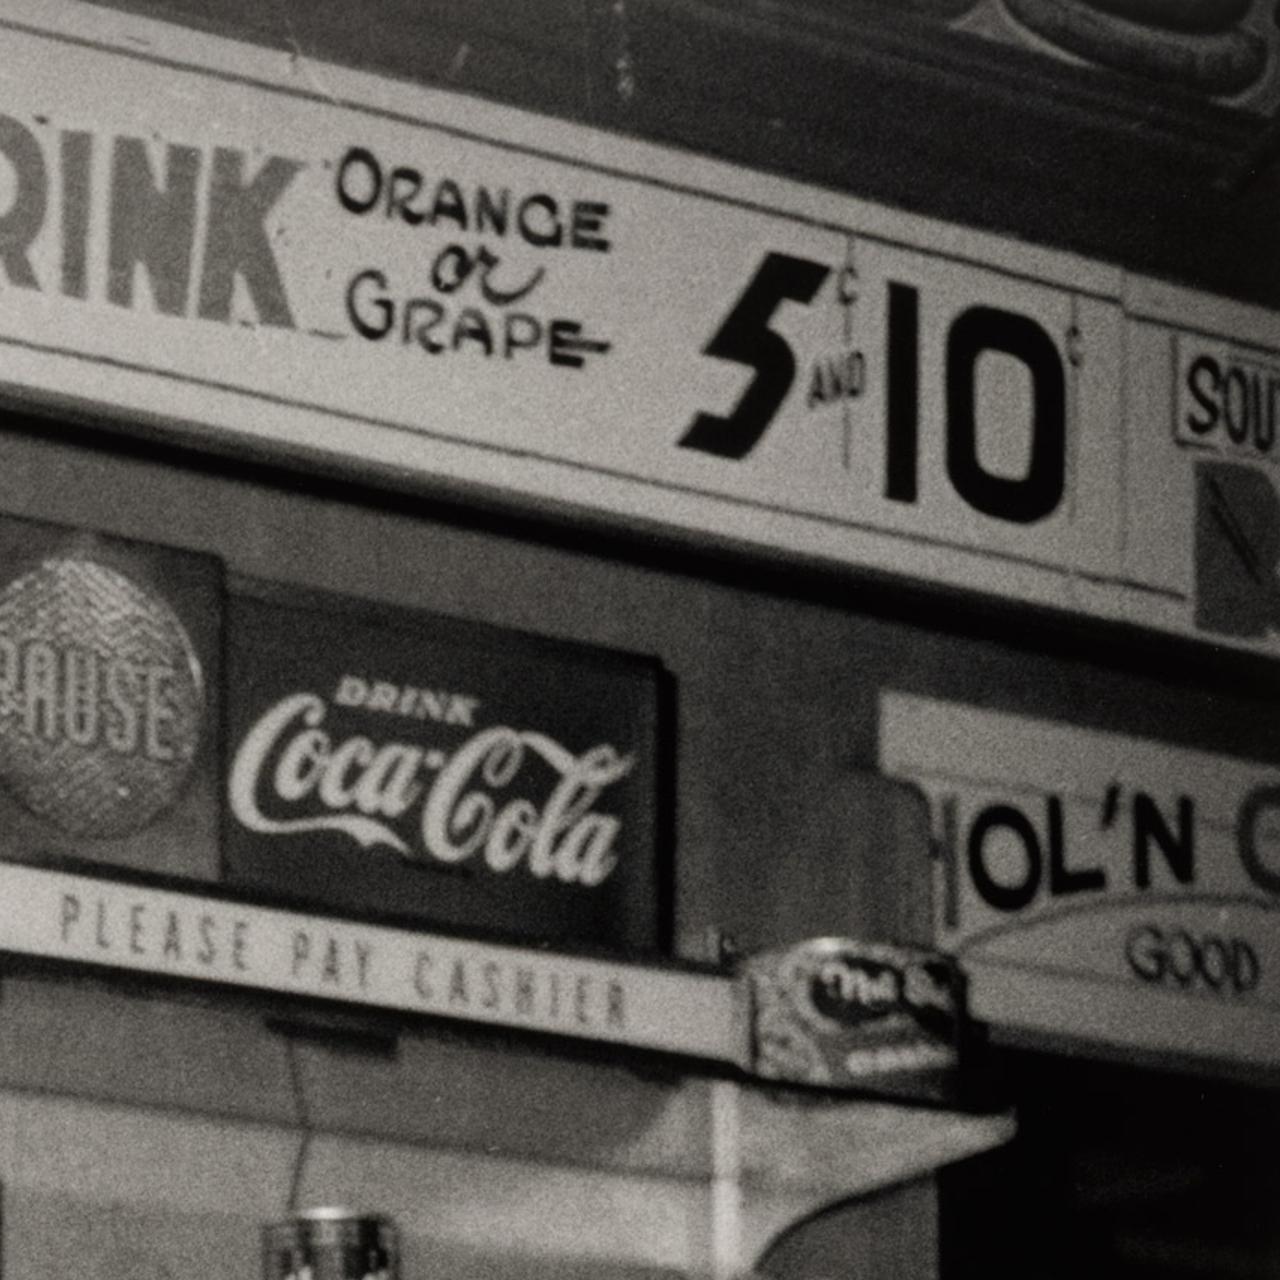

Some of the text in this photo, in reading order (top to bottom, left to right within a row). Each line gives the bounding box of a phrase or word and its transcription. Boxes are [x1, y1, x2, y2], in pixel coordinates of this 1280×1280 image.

[336, 146, 611, 253] ORANGE
[346, 269, 611, 369] GRAPE
[431, 244, 545, 307] or
[336, 675, 480, 727] DRINK
[228, 691, 636, 887] Coca-Cola
[967, 782, 1196, 913] OL'N
[57, 893, 631, 1031] PLEASE PAY CASHIER
[1125, 925, 1260, 993] GOOD
